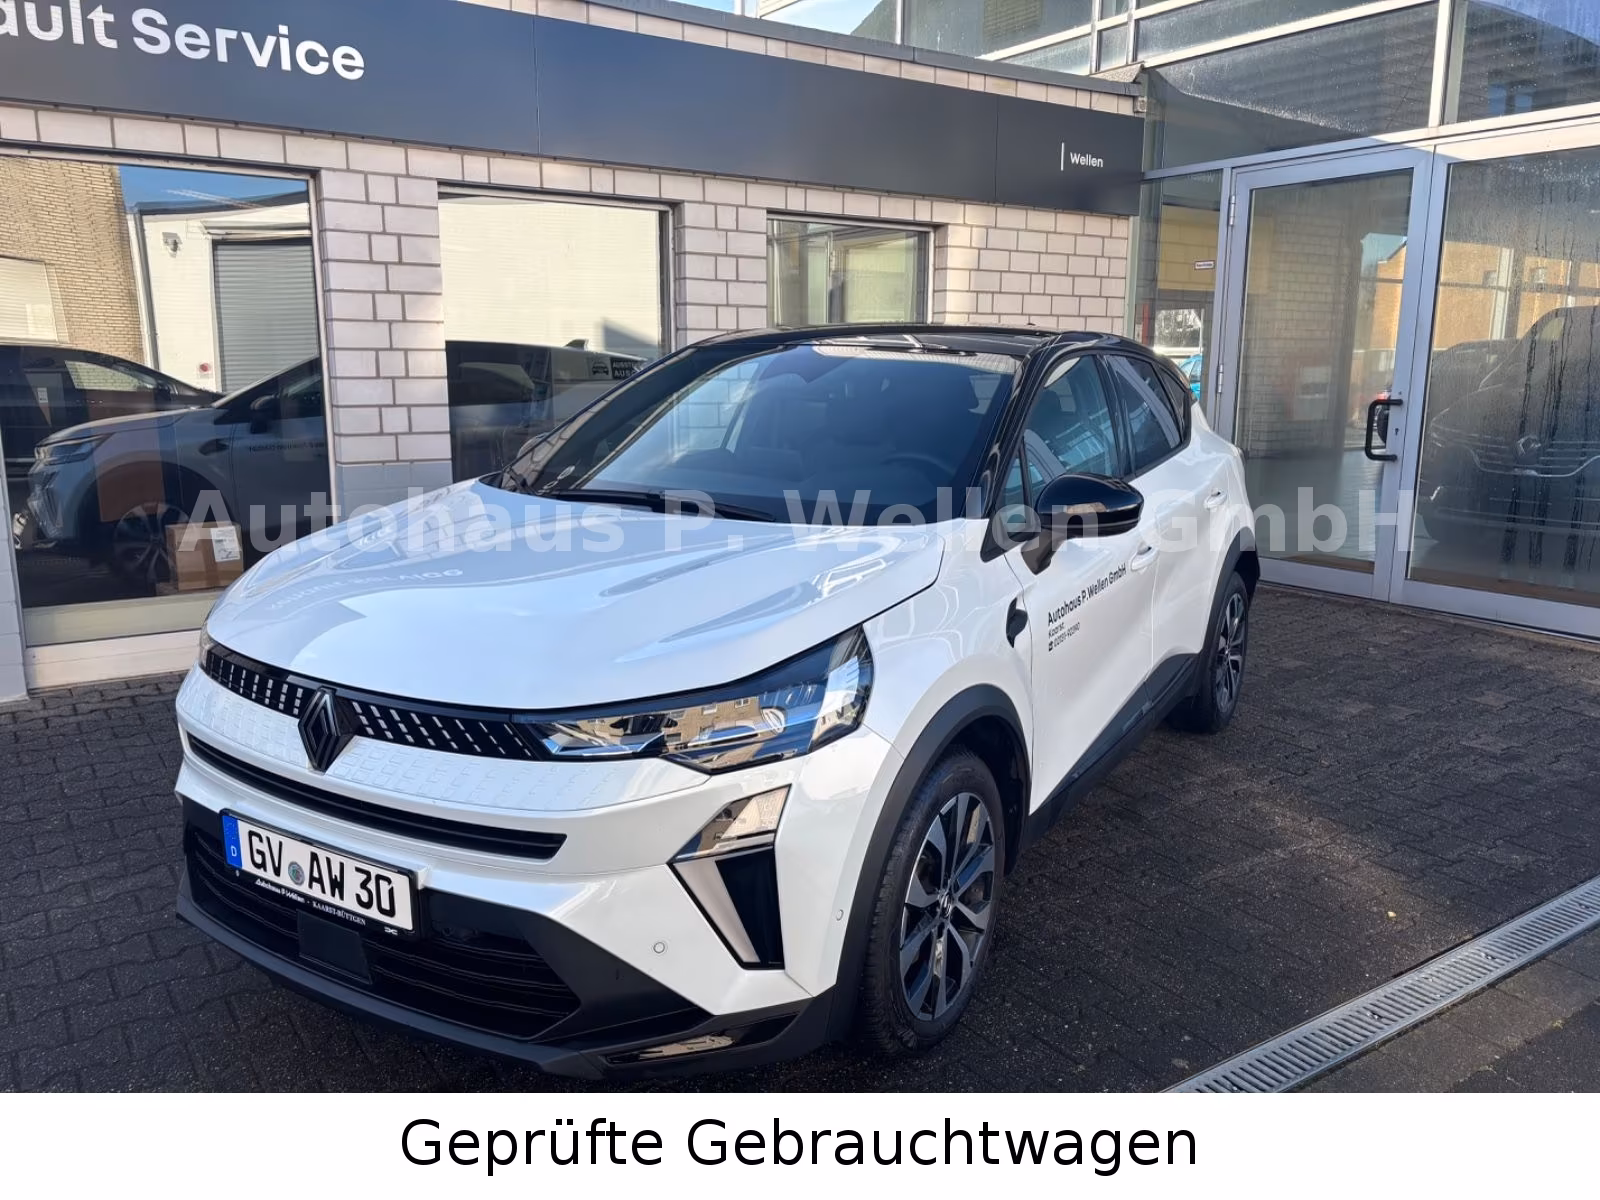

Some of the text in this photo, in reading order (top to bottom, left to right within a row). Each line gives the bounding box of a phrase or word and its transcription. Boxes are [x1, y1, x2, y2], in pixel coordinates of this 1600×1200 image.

[131, 8, 365, 80] Service
[1070, 152, 1104, 168] Wellen
[1048, 596, 1082, 627] Autohaus
[1087, 576, 1109, 599] Wellen
[1108, 562, 1127, 585] GmbH
[230, 845, 238, 857] D
[247, 830, 396, 918] GV AW 30
